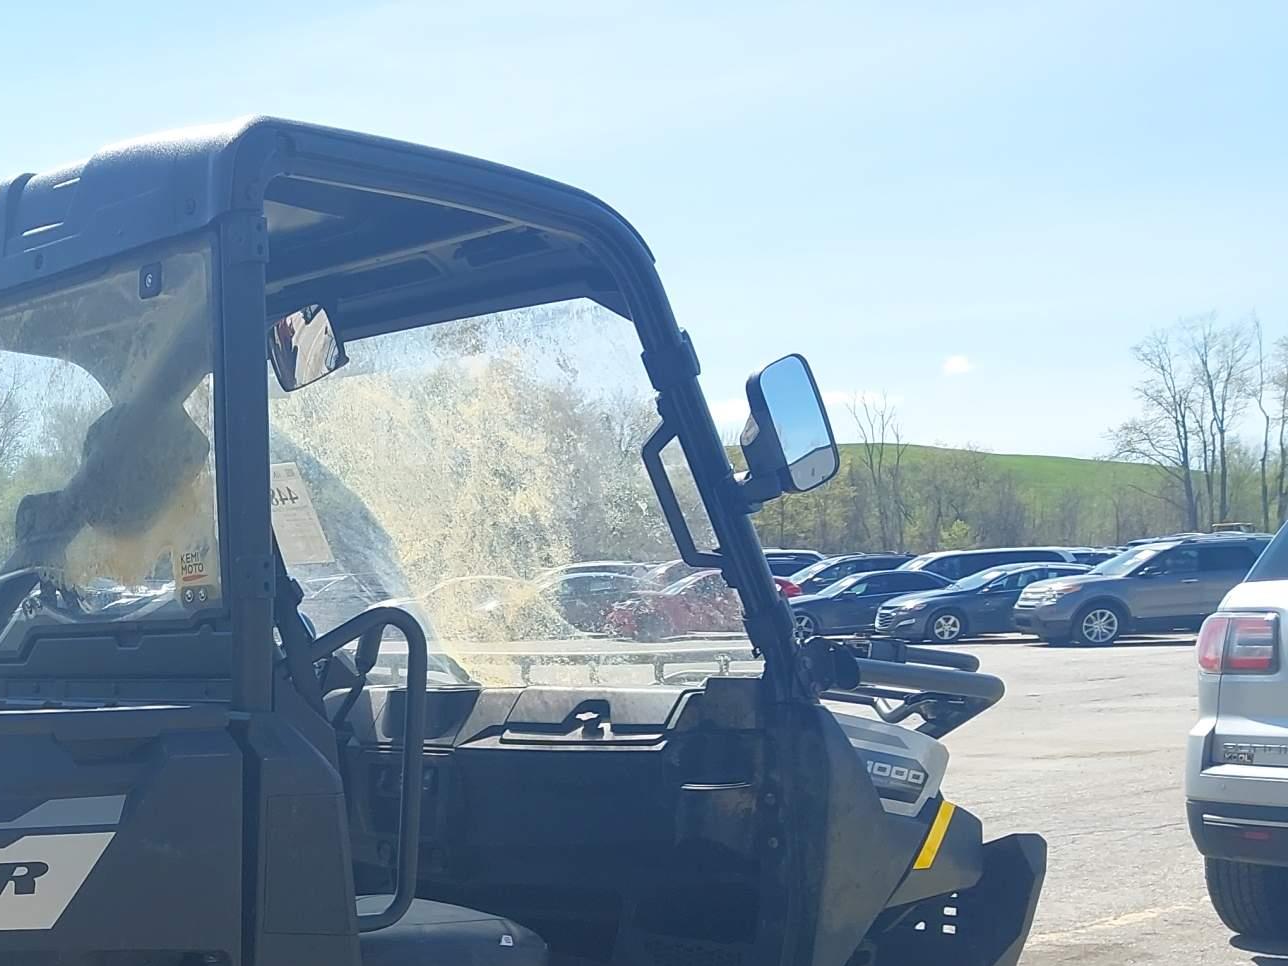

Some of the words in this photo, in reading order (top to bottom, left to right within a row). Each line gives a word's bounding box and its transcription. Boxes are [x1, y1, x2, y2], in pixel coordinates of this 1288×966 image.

[180, 551, 200, 564] KEMI
[181, 562, 204, 576] MOTO
[866, 760, 925, 785] 1000
